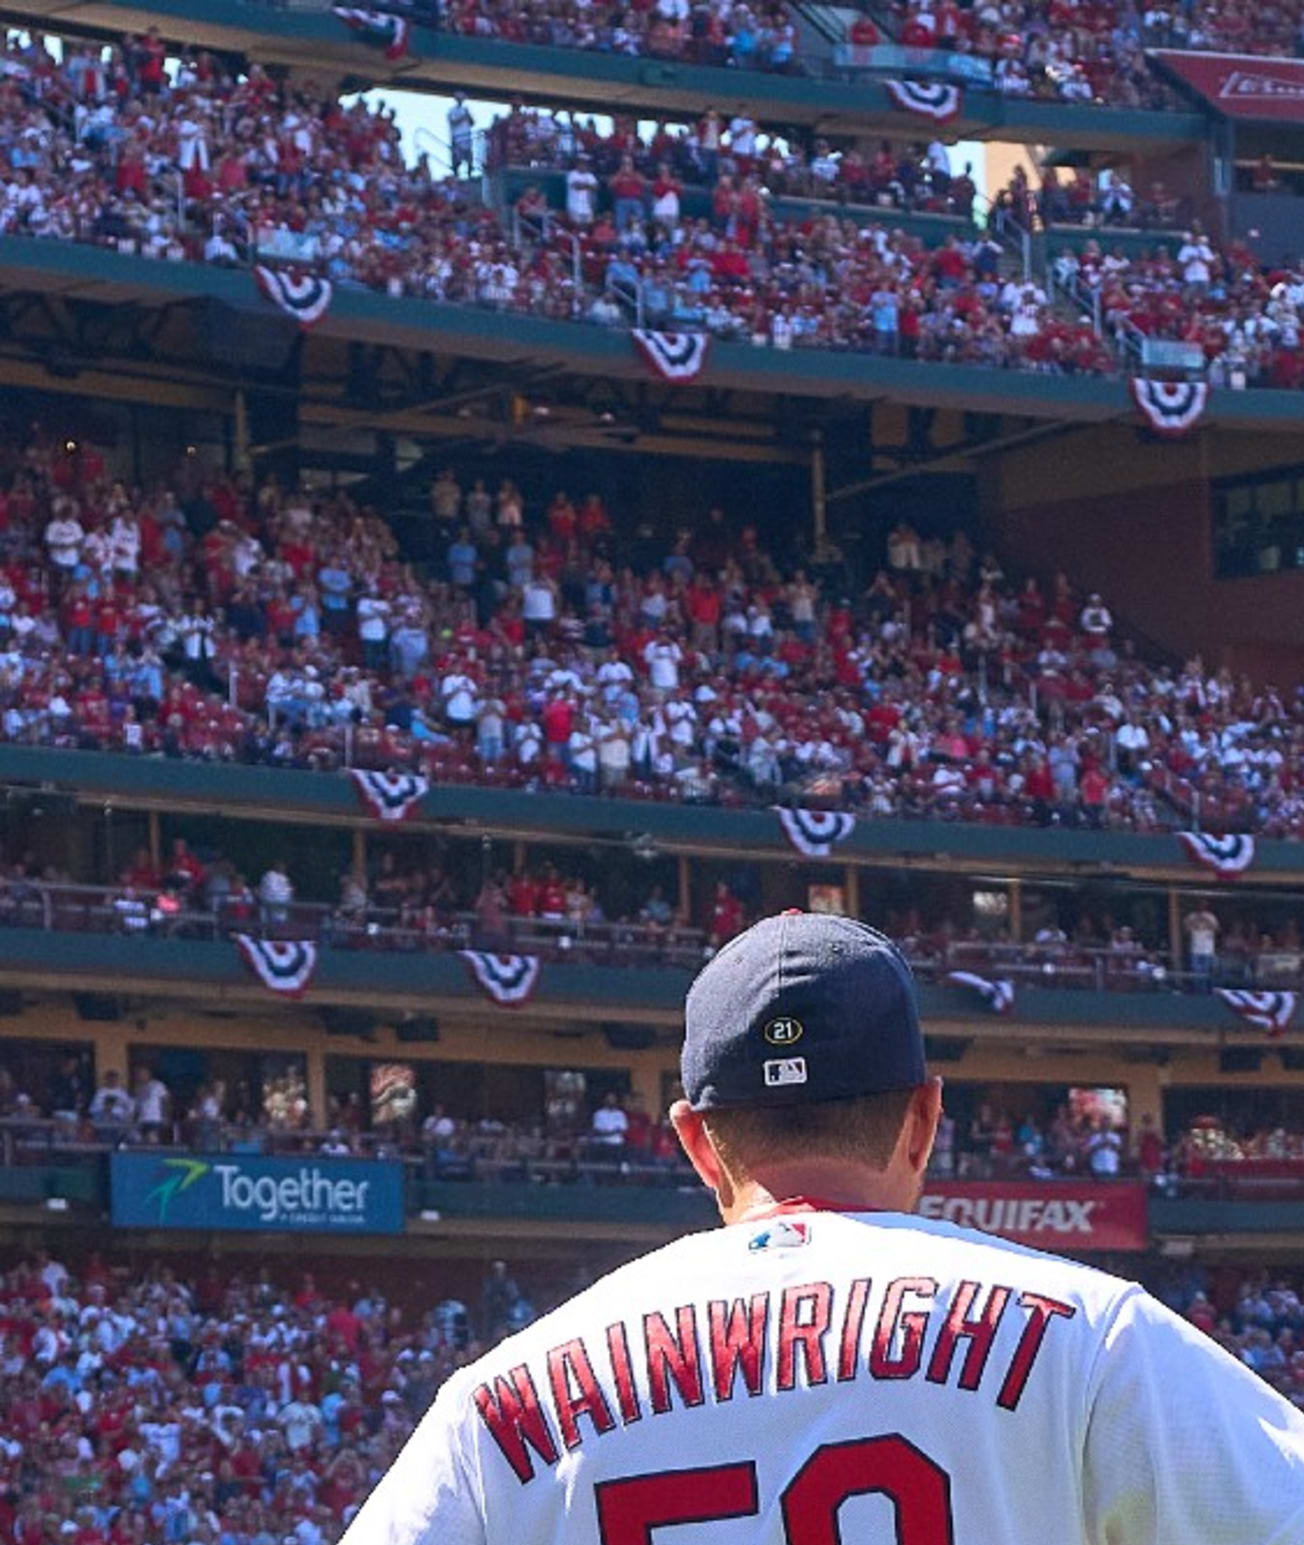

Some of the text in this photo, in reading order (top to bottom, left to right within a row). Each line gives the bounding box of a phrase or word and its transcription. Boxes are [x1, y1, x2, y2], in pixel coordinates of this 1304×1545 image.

[773, 1020, 794, 1039] 21
[213, 1165, 370, 1221] Together
[919, 1195, 1096, 1232] EQUIFAX
[473, 1276, 1075, 1485] WAINWRIGHT
